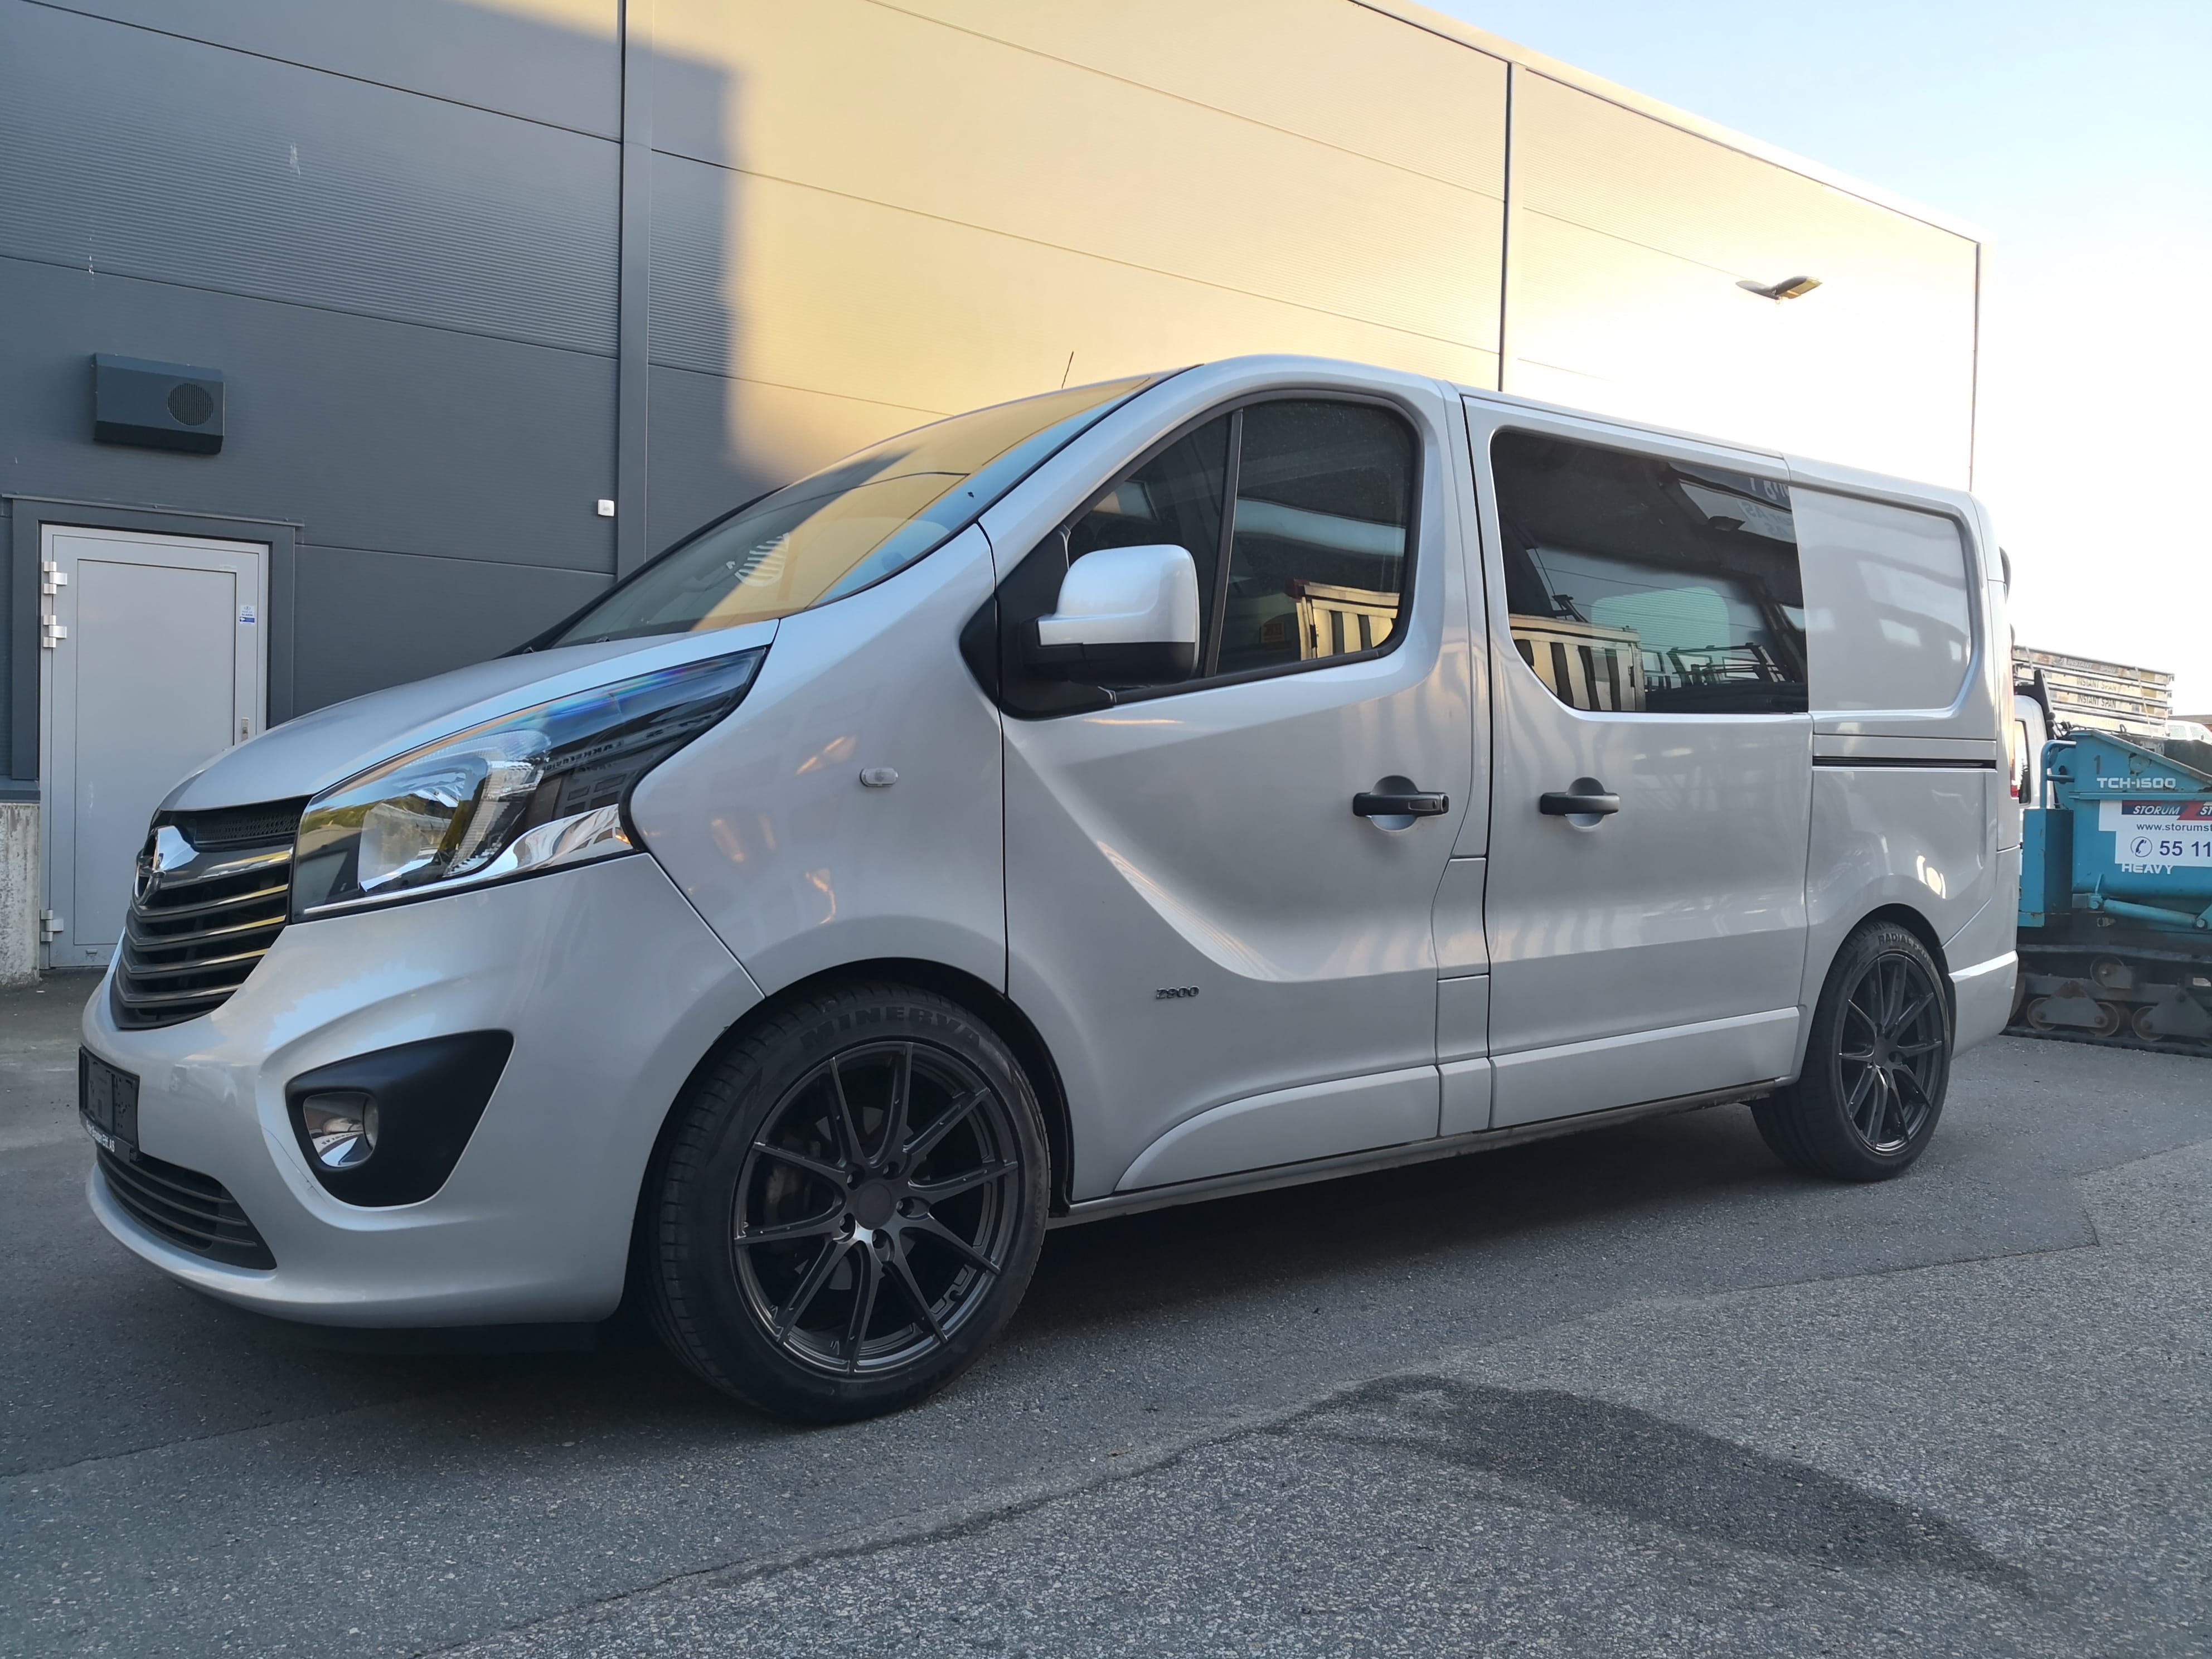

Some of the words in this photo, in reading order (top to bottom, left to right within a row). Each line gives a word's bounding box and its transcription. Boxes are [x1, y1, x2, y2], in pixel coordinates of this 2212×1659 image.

[2077, 677, 2099, 689] INSTANT
[2101, 683, 2117, 692] SPAN
[2078, 693, 2099, 706] INSTANT
[2101, 698, 2117, 709] SPAN
[2097, 777, 2176, 789] TCH-1500
[2133, 806, 2181, 815] STORUM
[2159, 840, 2183, 856] 55
[2191, 841, 2211, 857] 11
[2122, 864, 2174, 875] HEAVY
[1156, 985, 1200, 1000] 2900
[799, 1006, 981, 1050] MINERVA
